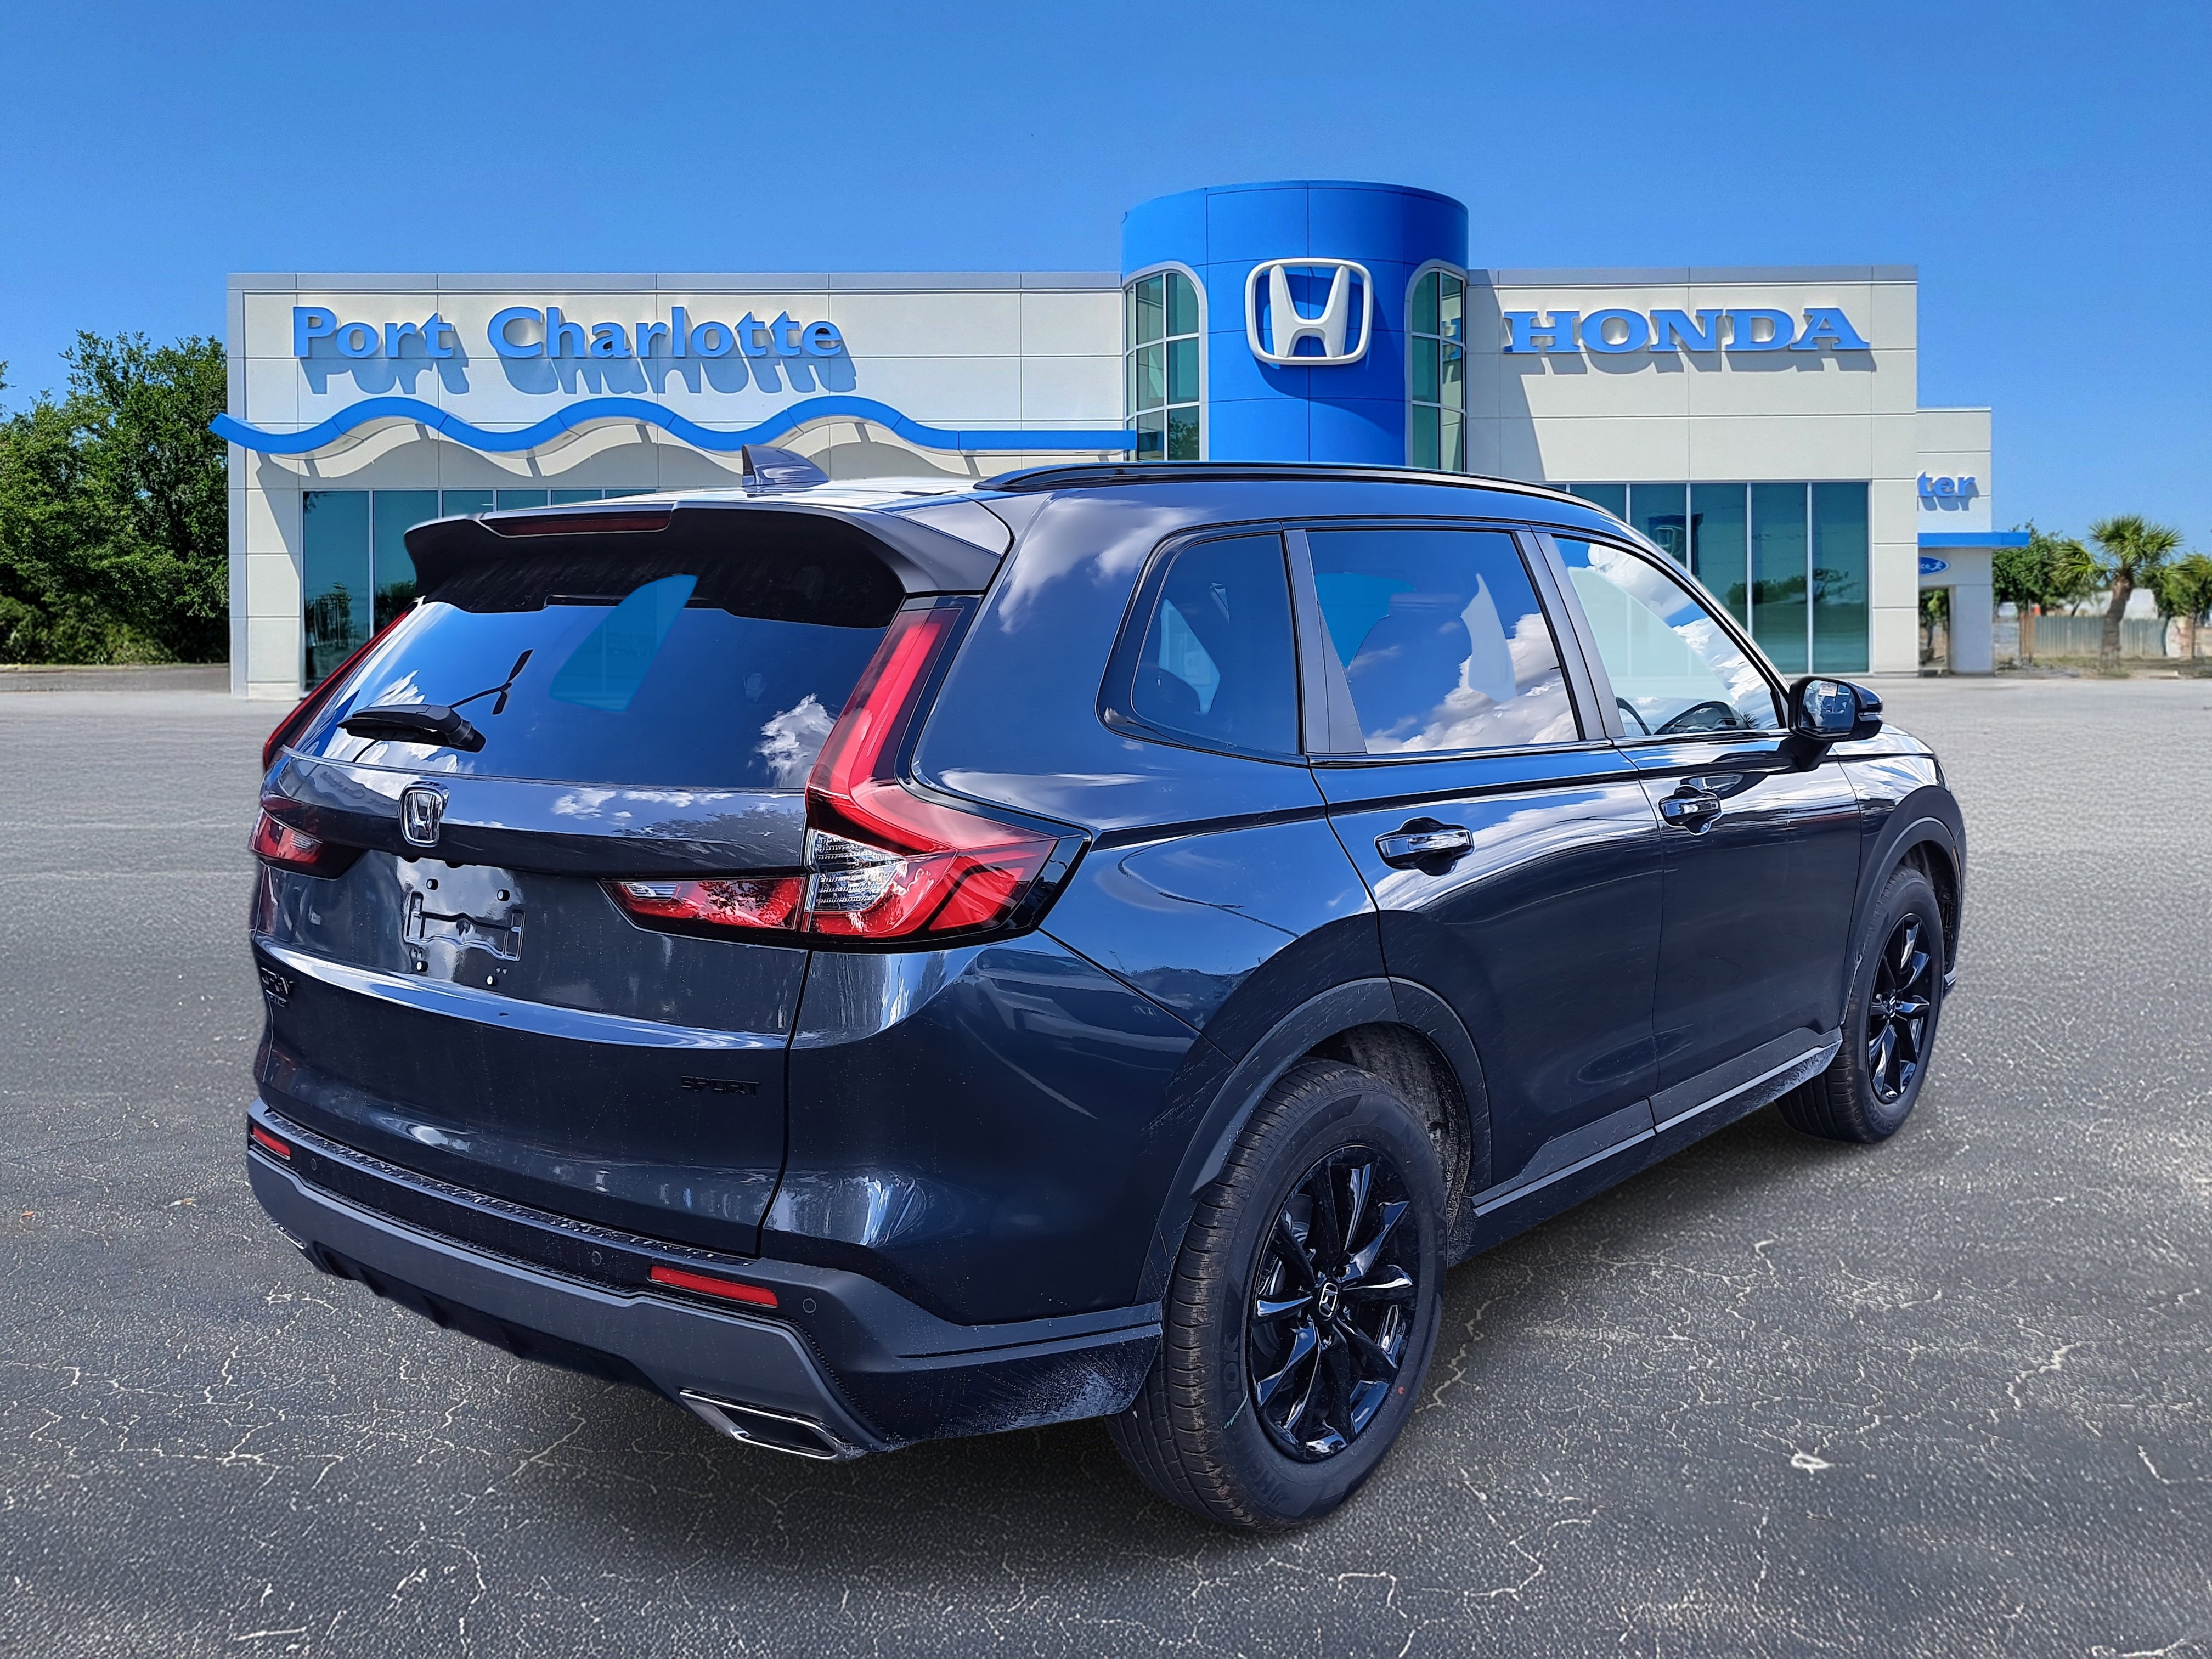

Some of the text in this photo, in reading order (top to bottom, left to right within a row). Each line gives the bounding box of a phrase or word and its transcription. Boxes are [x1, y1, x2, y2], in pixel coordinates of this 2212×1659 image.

[293, 306, 842, 358] Port Charlotte
[1503, 308, 1870, 353] HONDA
[1917, 471, 1976, 498] ter
[681, 1075, 760, 1097] SPORT
